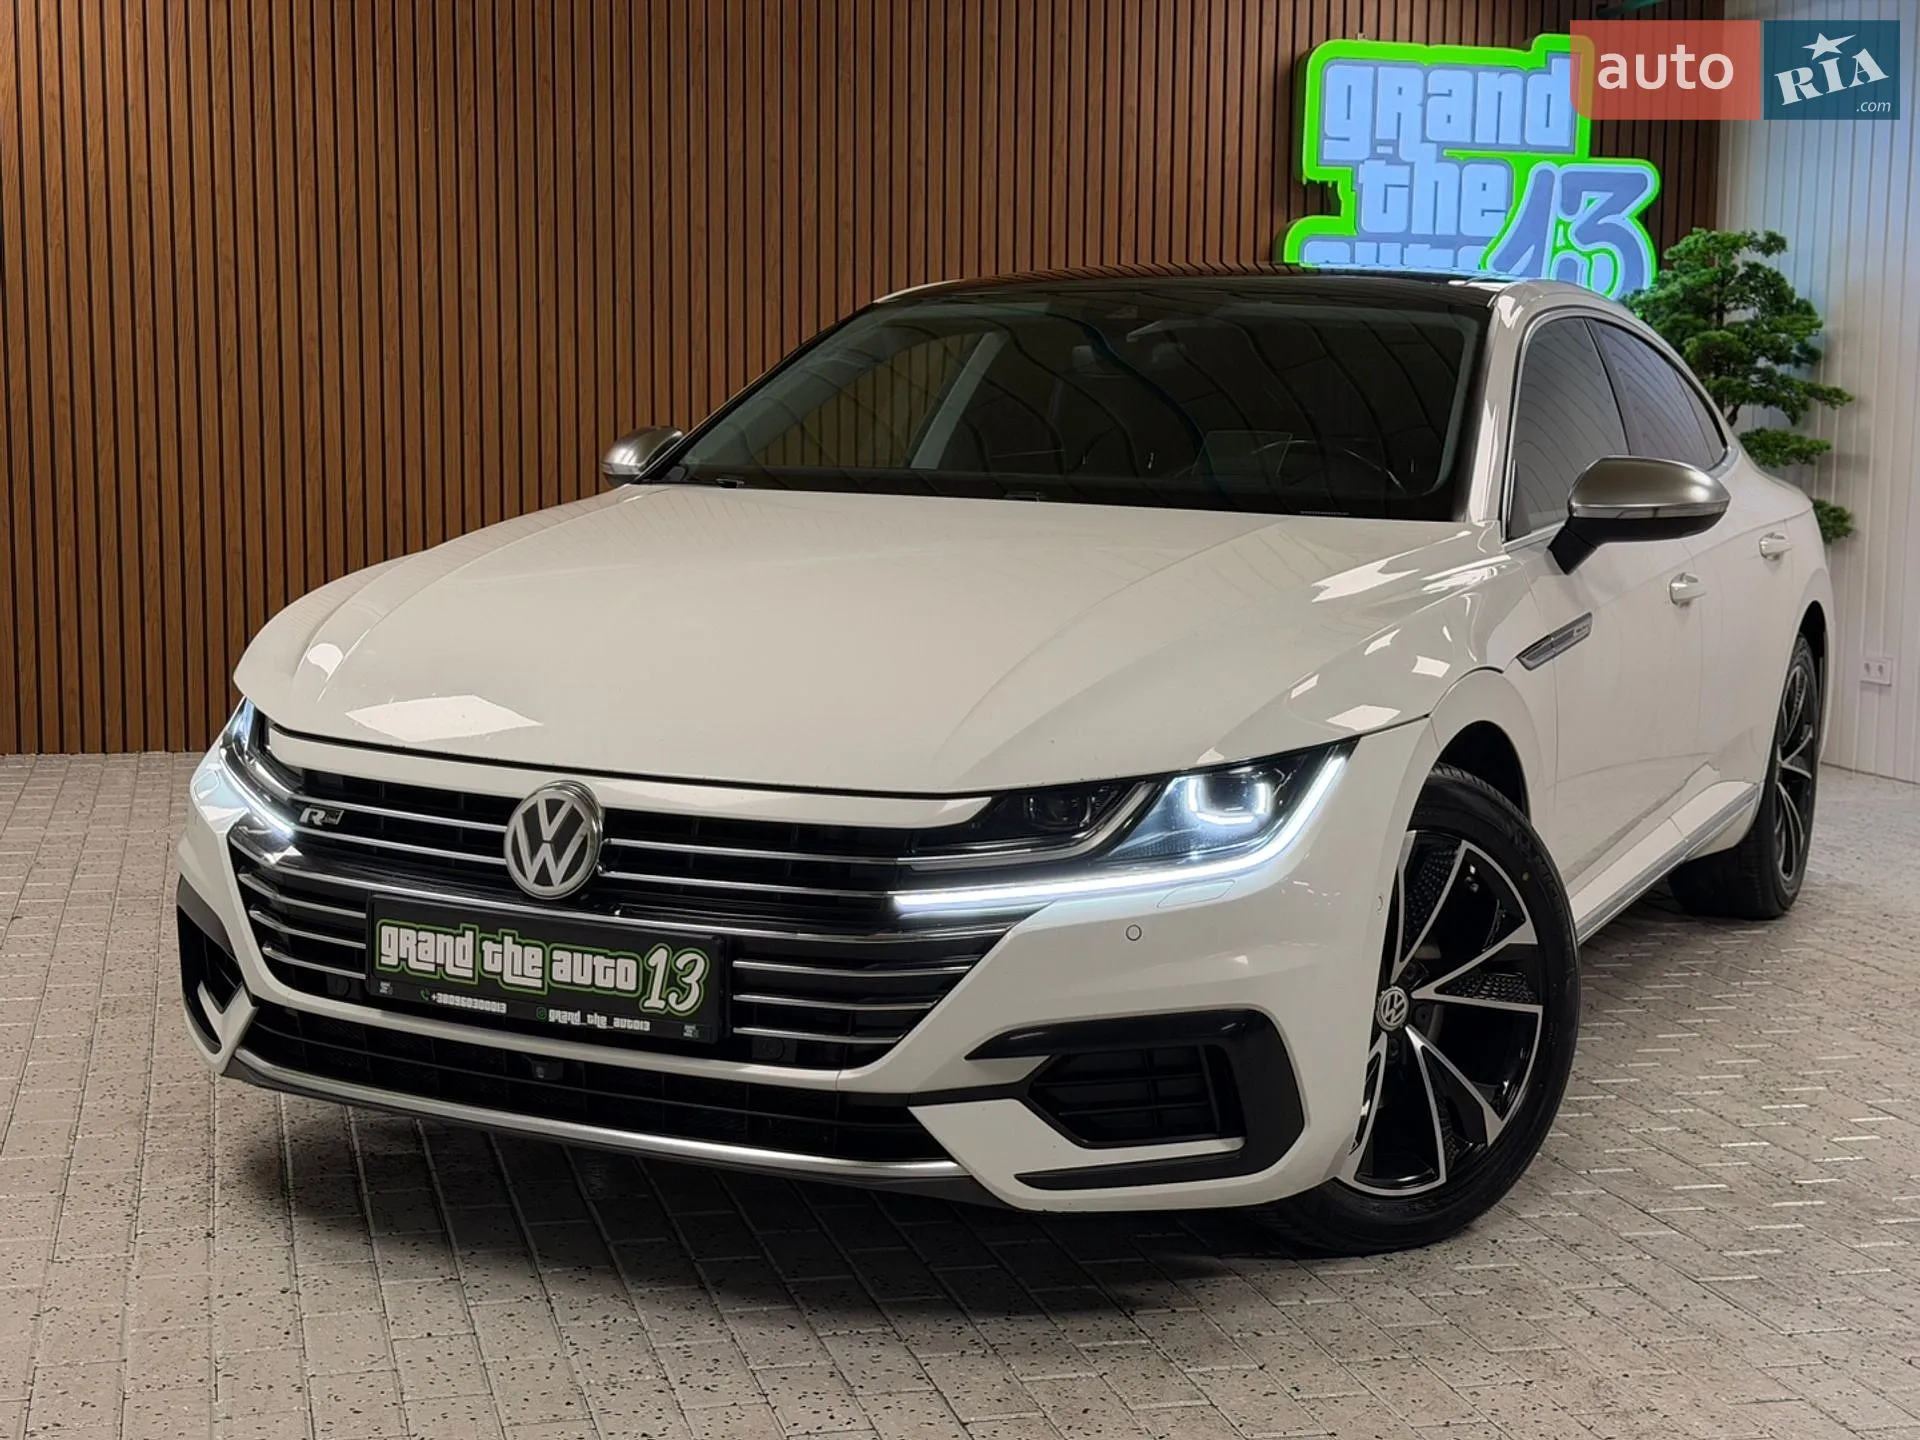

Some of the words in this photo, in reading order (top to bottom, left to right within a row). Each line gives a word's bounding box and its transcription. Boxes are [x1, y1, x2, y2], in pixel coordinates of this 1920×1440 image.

[1359, 146, 1510, 237] the
[1487, 162, 1656, 298] 13
[380, 926, 474, 979] grand
[481, 936, 543, 988] the
[552, 950, 638, 991] auto
[643, 947, 706, 1013] 13
